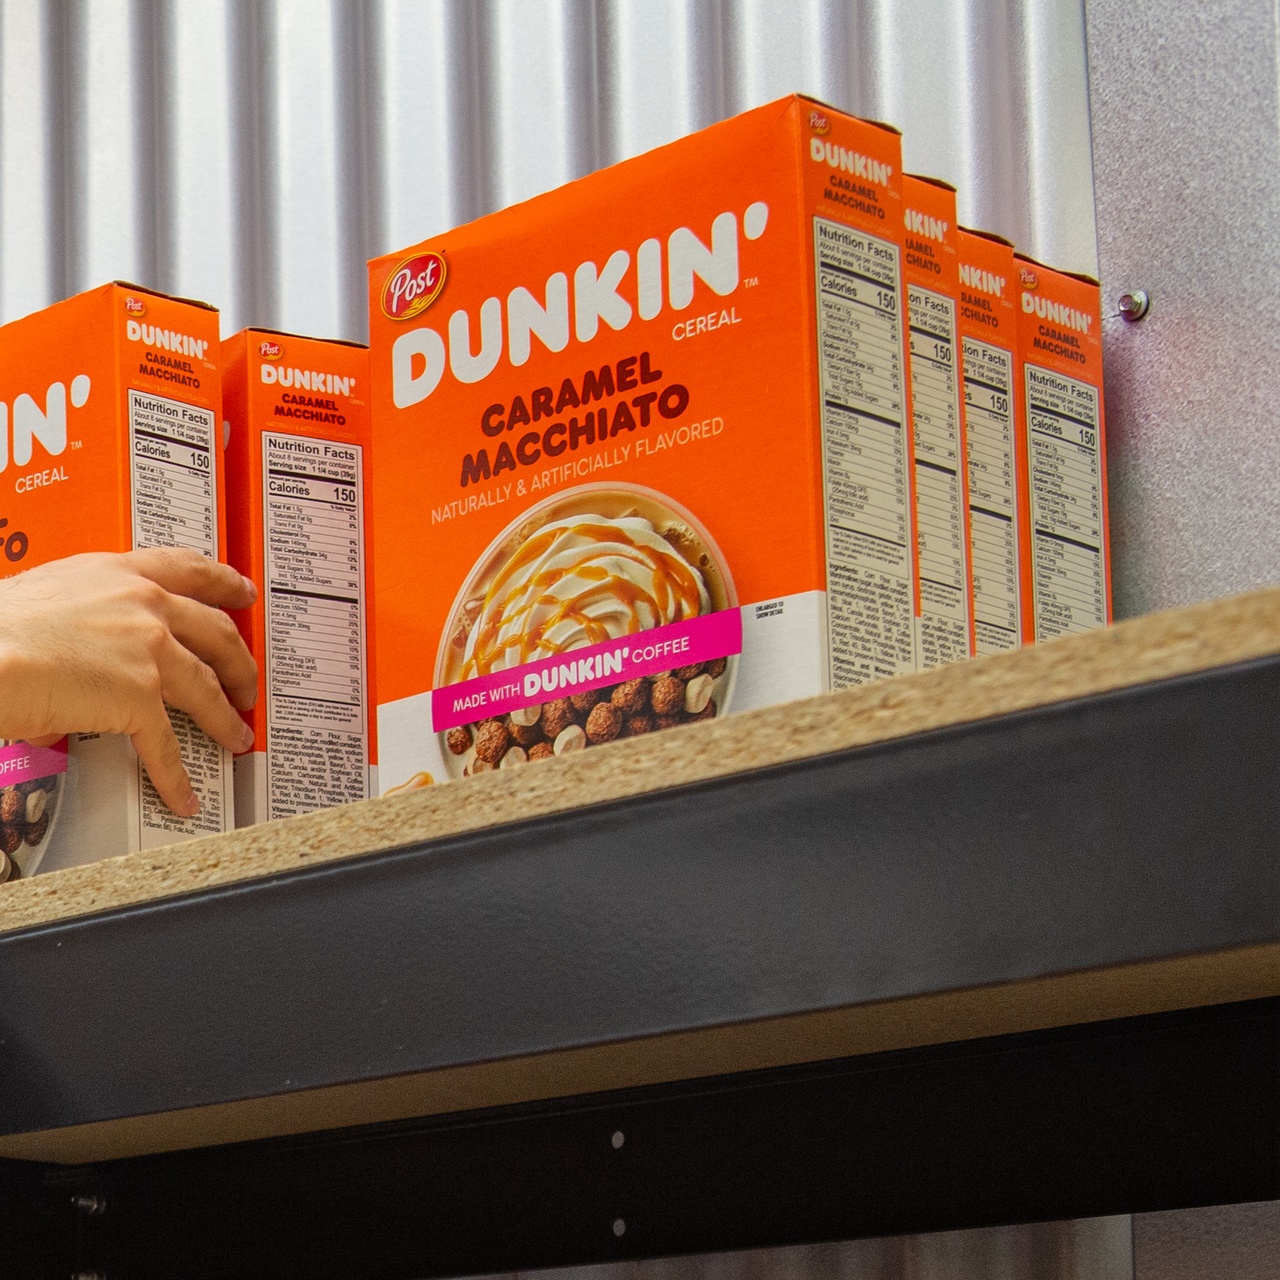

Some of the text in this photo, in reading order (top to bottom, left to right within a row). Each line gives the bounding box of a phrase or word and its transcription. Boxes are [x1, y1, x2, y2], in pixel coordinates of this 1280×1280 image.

[810, 138, 892, 187] DUNKIN'
[824, 188, 885, 220] MACCHIATO
[829, 175, 878, 202] CARAMEL
[819, 225, 894, 262] Nutrition Facts
[391, 259, 438, 313] Post
[821, 275, 896, 311] Calories 150
[392, 201, 769, 409] DUNKIN'
[1021, 292, 1093, 335] DUNKIN'
[671, 307, 742, 341] CEREAL
[1038, 324, 1081, 349] CARAMEL
[126, 320, 208, 360] DUNKIN'
[260, 343, 279, 355] Post
[1033, 336, 1086, 365] MACCHIATO
[139, 364, 200, 389] MACCHIATO
[145, 352, 194, 373] CARAMEL
[261, 364, 356, 397] DUNKIN'
[481, 352, 663, 437] CARAMEL
[1029, 371, 1094, 403] Nutrition Facts
[134, 397, 208, 425] Nutrition Facts
[274, 406, 346, 426] MACCHIATO
[282, 393, 339, 411] CARAMEL
[460, 384, 689, 487] MACCHIATO
[1031, 416, 1096, 447] Calories 150
[135, 441, 209, 469] Calories 150
[268, 438, 355, 460] Nutrition Facts
[269, 452, 286, 460] About
[293, 456, 316, 465] servings
[329, 461, 355, 470] container
[15, 467, 69, 494] CEREAL
[269, 460, 293, 470] Serving
[431, 416, 725, 526] NATURALLY & ARTIFICIALLY FLAVORED
[269, 481, 356, 503] Calories 150
[452, 636, 690, 713] MADE WITH DUNKIN' COFFEE
